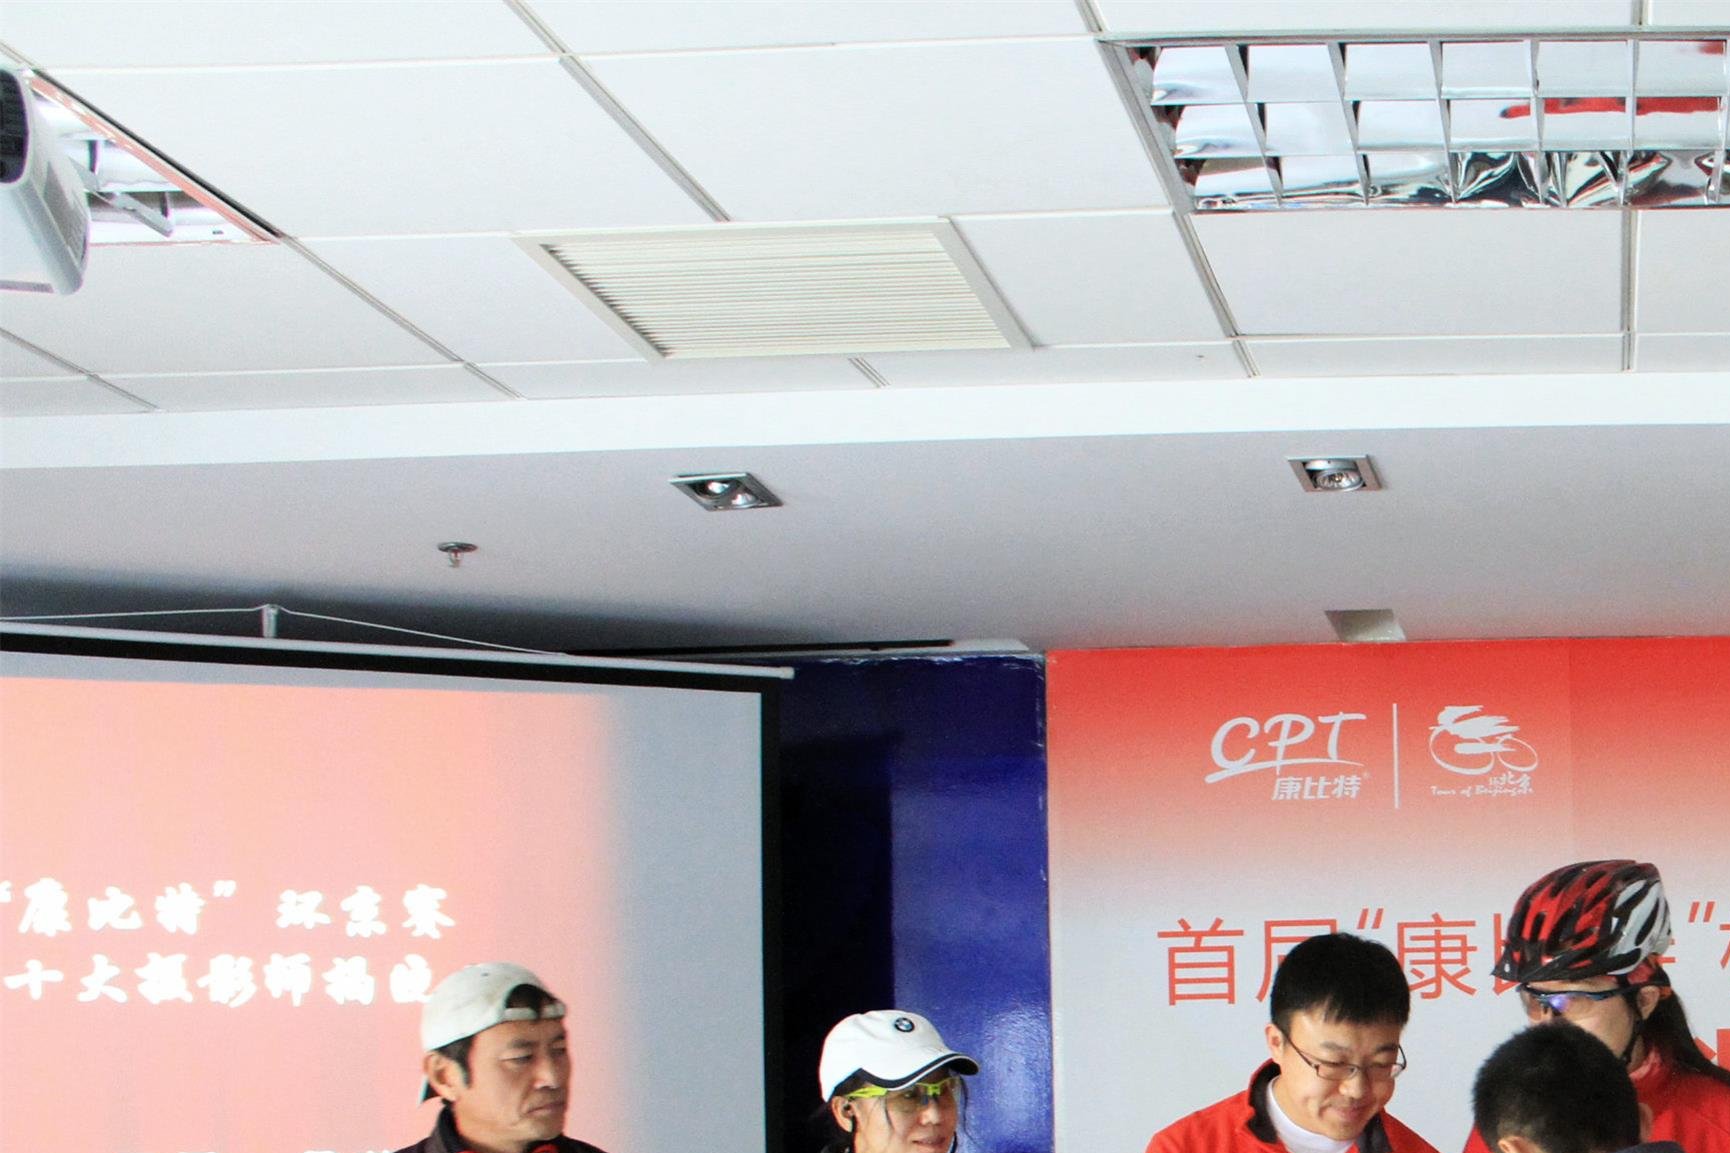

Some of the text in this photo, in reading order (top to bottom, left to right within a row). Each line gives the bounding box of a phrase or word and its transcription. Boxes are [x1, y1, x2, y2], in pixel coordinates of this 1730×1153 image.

[1207, 711, 1367, 778] CPT
[1272, 776, 1361, 801] 康比特
